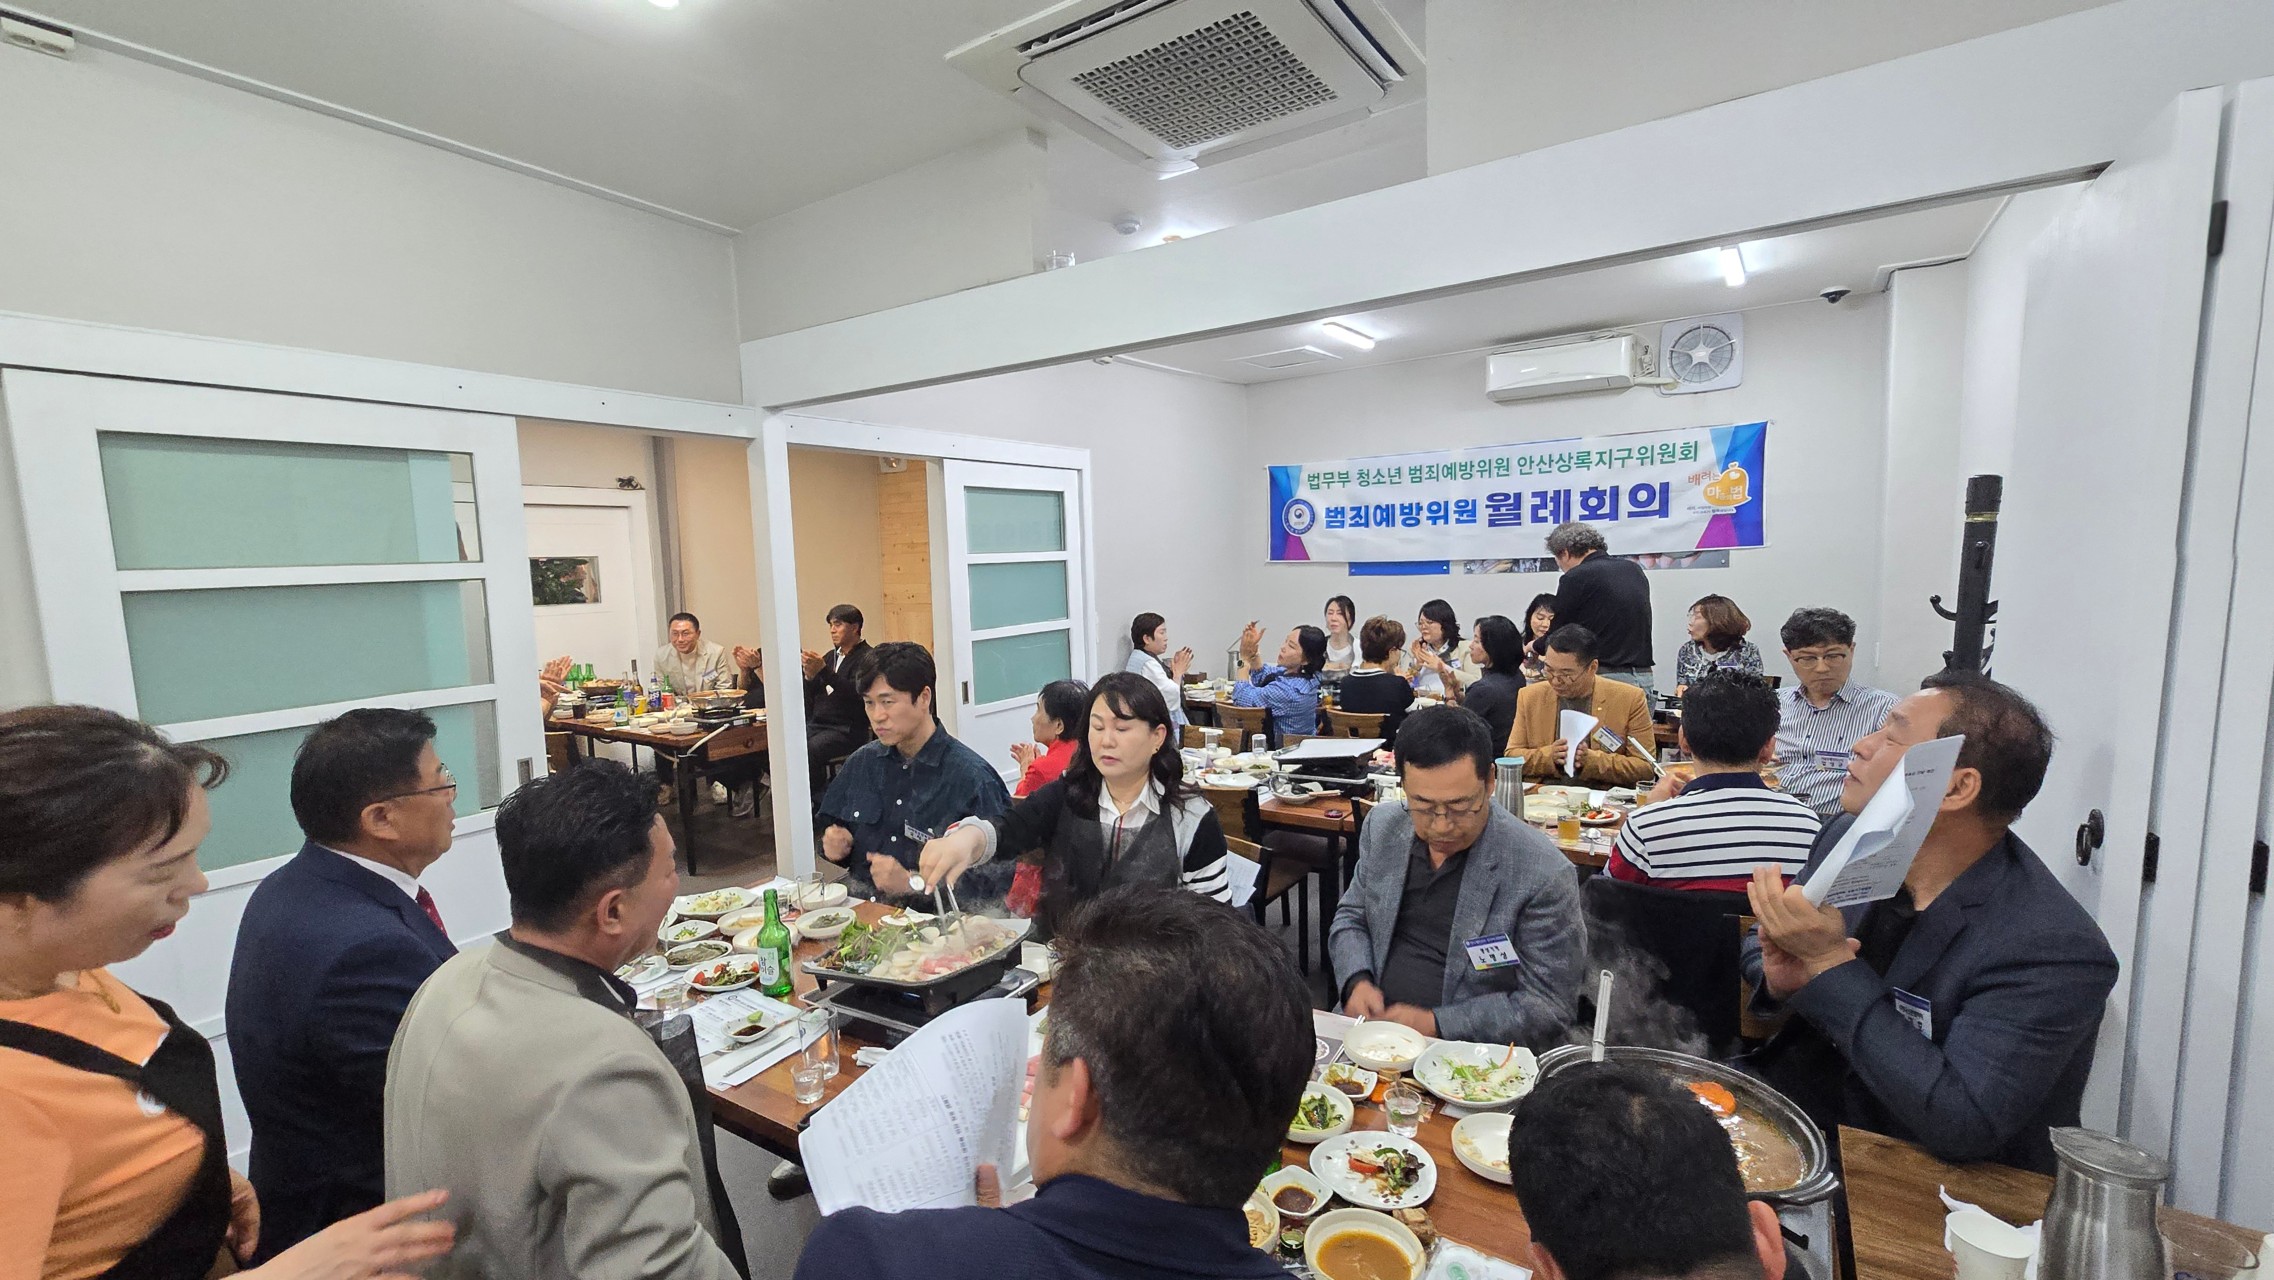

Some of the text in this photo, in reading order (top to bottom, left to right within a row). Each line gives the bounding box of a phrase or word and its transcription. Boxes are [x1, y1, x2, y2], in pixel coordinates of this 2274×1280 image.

[1307, 440, 1699, 490] 법무부 청소년 범죄예방위원 안산상록지구위원회
[1324, 498, 1478, 529] 범죄예방위원
[1485, 481, 1670, 528] 월례회의
